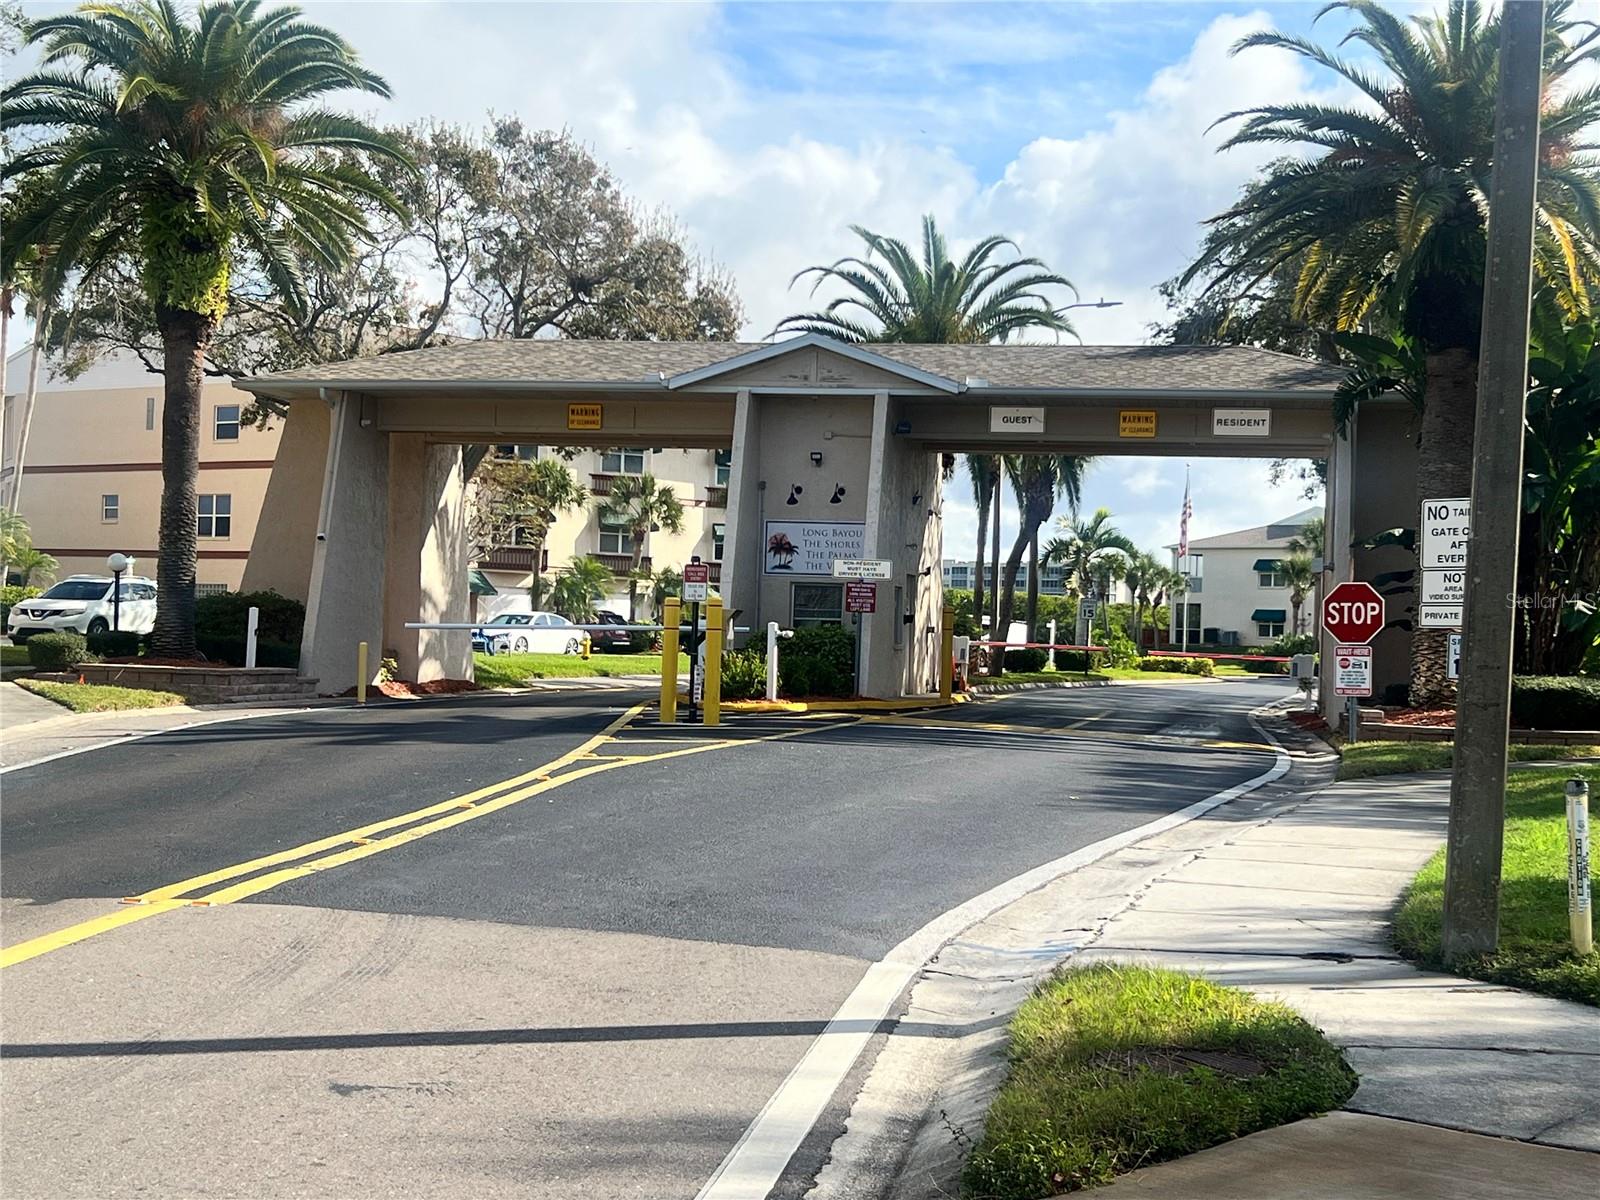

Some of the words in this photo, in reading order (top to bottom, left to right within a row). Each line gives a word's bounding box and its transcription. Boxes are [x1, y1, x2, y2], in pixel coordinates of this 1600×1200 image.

[570, 407, 600, 416] WARNING
[1002, 416, 1032, 424] GUEST
[1122, 416, 1154, 424] WARNING
[1216, 418, 1266, 427] RESIDENT
[1428, 506, 1450, 520] NO
[802, 528, 828, 537] LONG
[832, 529, 863, 538] BAYOU
[1432, 528, 1459, 536] GATE
[804, 540, 820, 548] THE
[824, 540, 860, 548] SHORES
[806, 551, 824, 559] THE
[828, 551, 857, 560] PALMS
[1437, 554, 1466, 563] EVER
[805, 561, 823, 570] THE
[1084, 610, 1094, 618] 15
[1328, 602, 1380, 624] STOP
